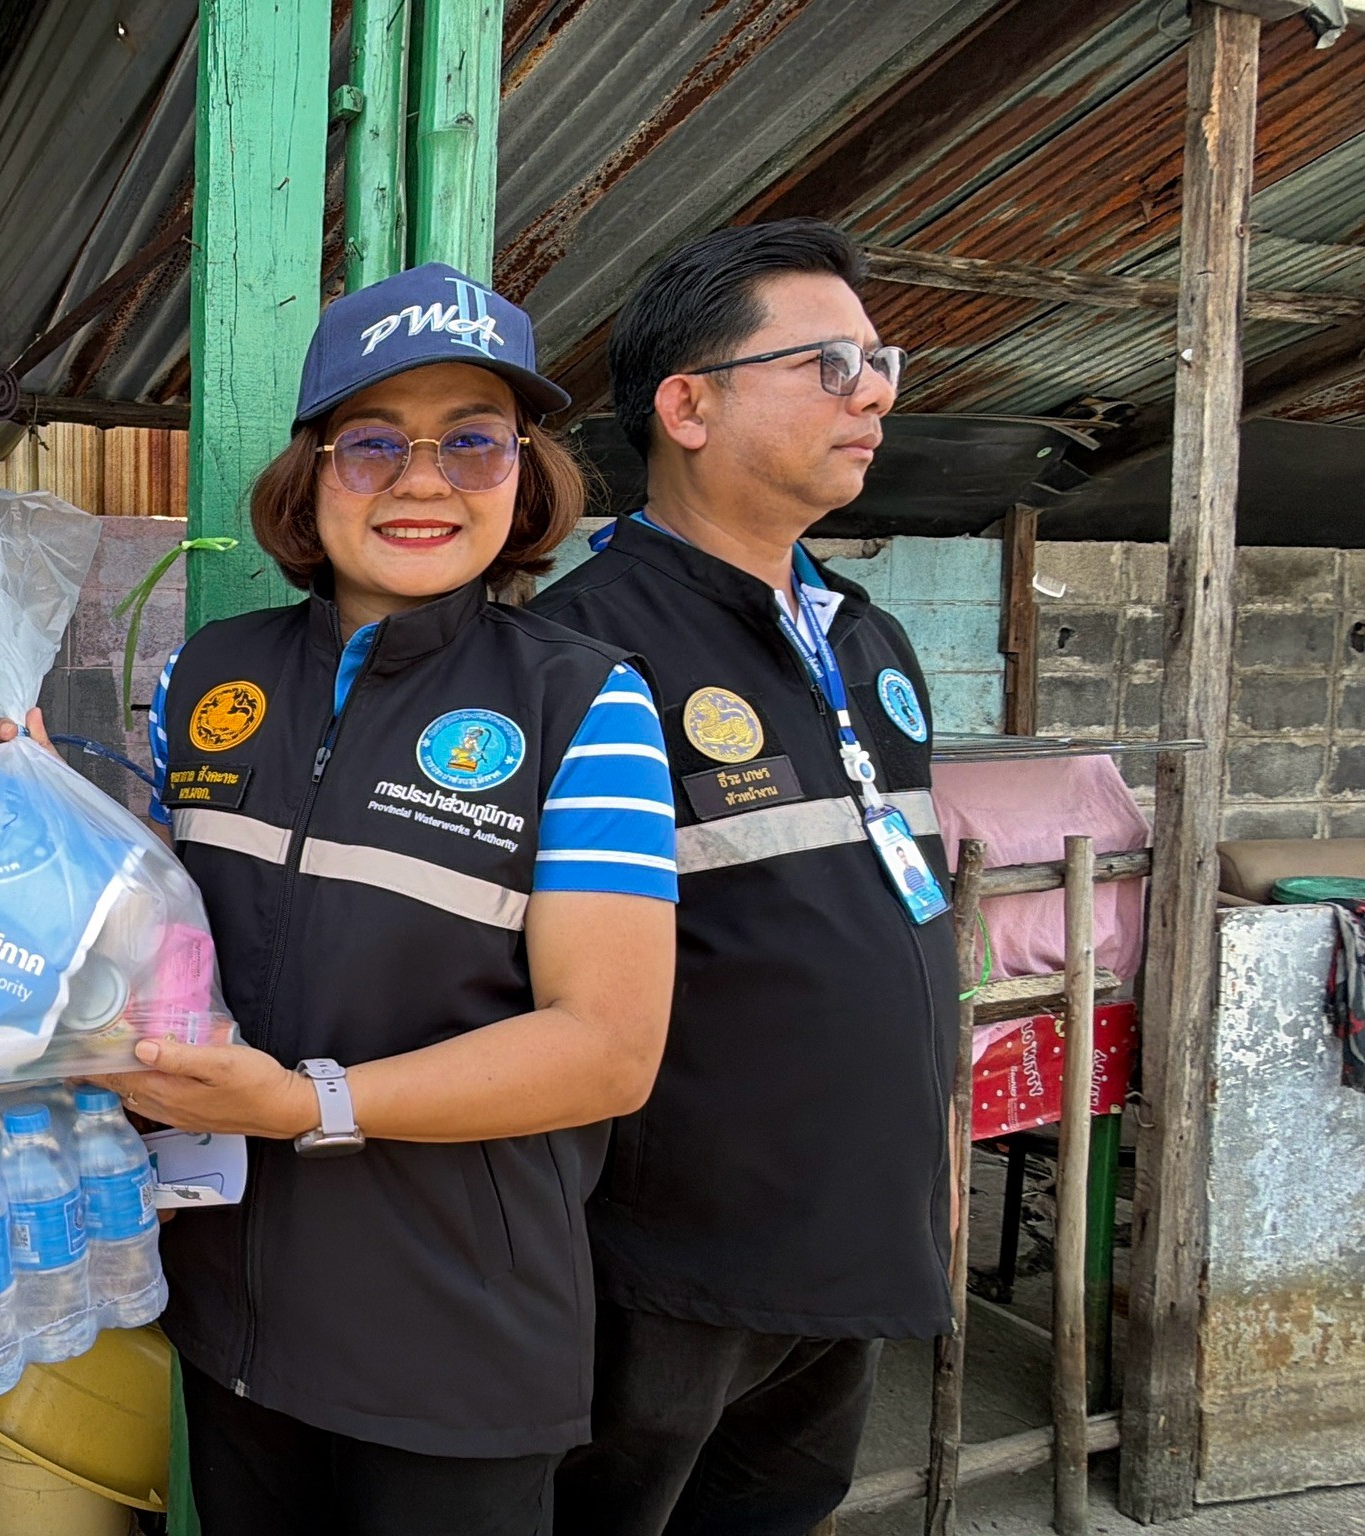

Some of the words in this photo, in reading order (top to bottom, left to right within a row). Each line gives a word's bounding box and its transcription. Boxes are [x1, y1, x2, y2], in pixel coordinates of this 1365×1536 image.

[367, 800, 412, 819] Provincial
[414, 810, 471, 836] Waterworks
[472, 829, 519, 853] Authority
[374, 780, 525, 833] การประปาส่วนภูมิภาค
[1022, 1041, 1044, 1097] KITTY
